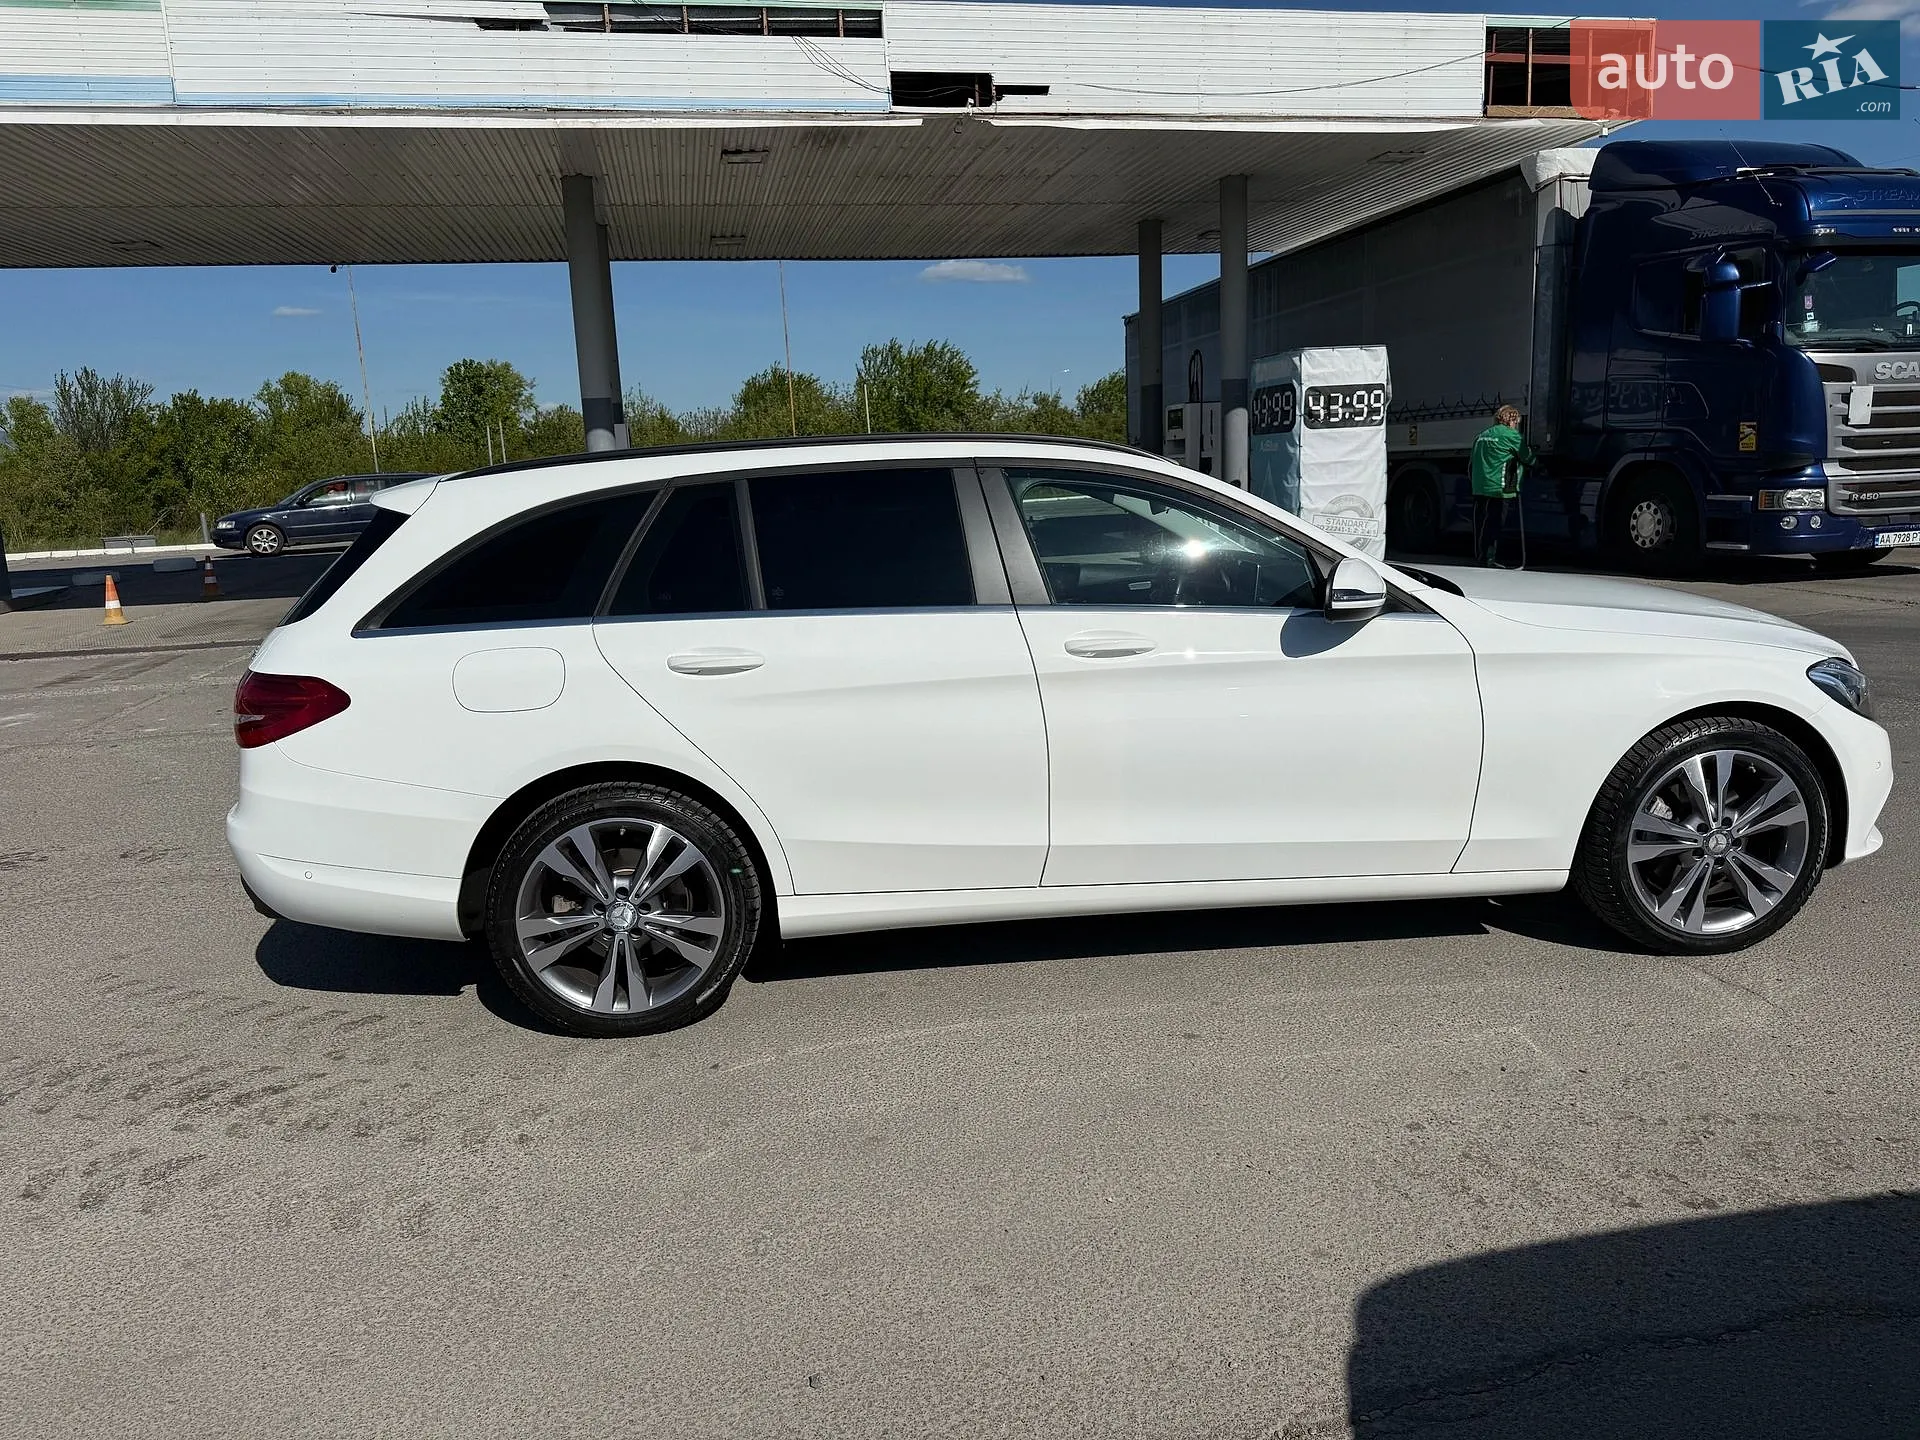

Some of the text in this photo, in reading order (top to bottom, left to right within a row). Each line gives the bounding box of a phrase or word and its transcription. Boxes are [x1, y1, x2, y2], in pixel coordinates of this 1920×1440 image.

[1308, 390, 1384, 422] 43:99
[1852, 492, 1879, 502] R 450
[1880, 534, 1891, 544] AA
[1893, 532, 1911, 543] 7928
